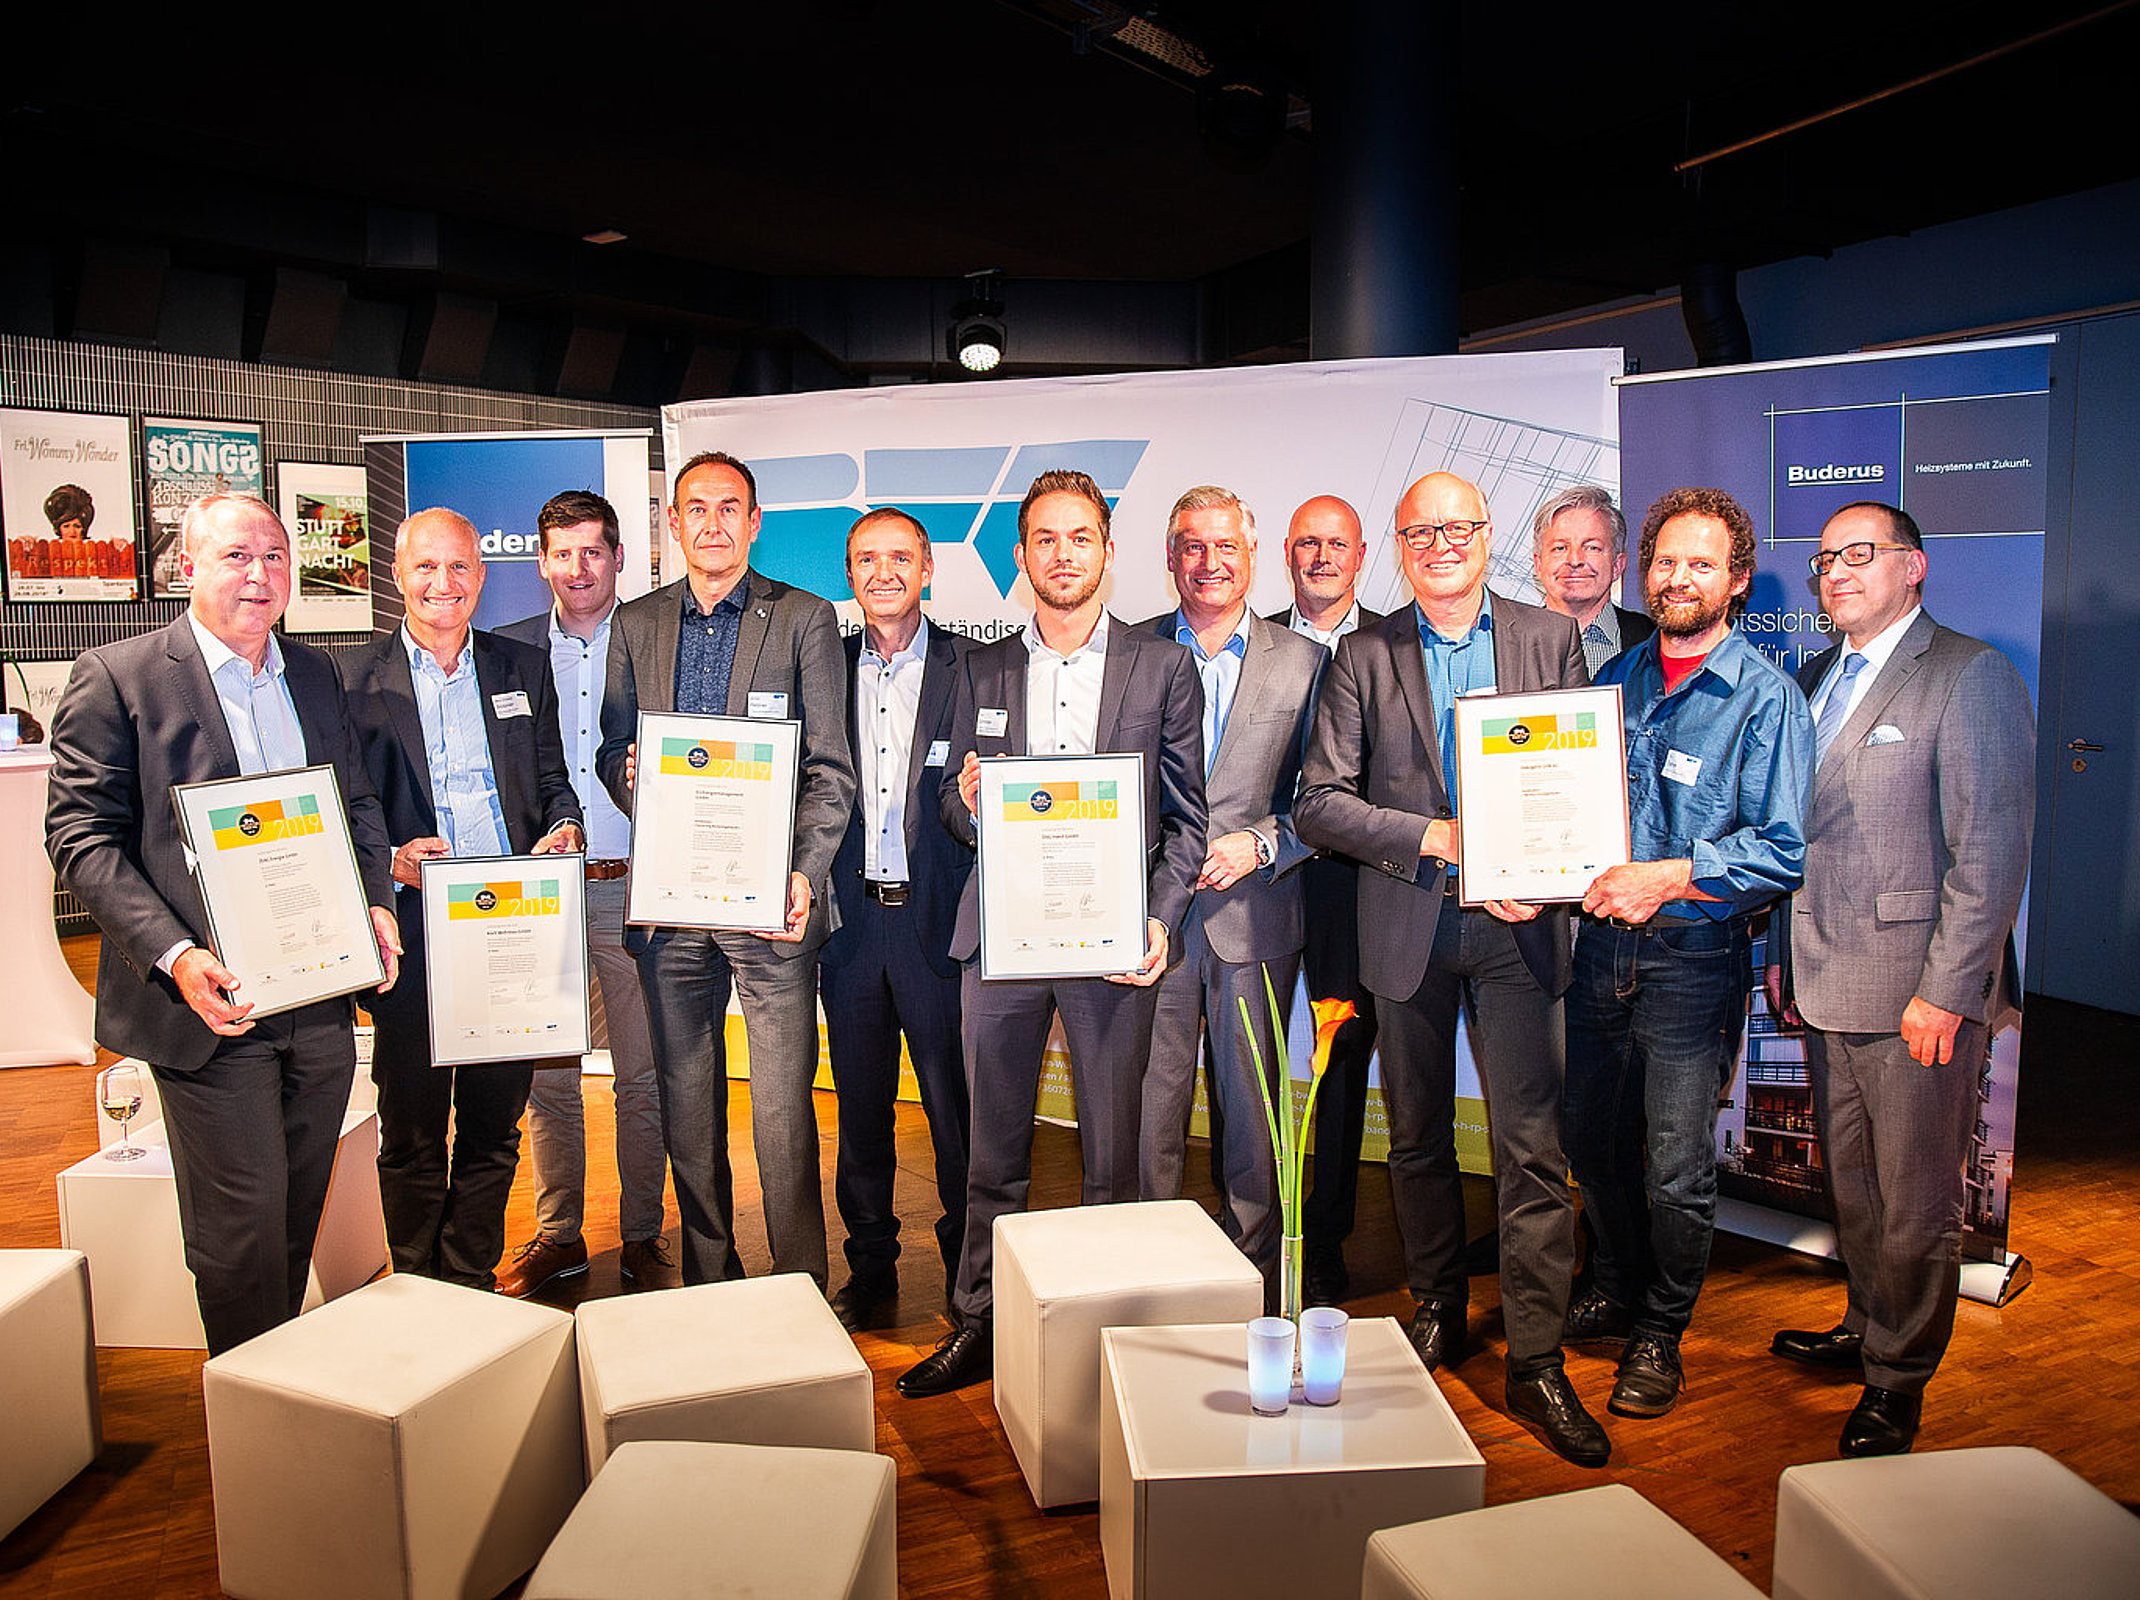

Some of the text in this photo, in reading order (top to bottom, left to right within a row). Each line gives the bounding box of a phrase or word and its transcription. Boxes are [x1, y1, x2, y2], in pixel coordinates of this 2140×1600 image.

[28, 437, 74, 463] Wommy
[75, 439, 119, 463] Wonder
[147, 436, 260, 475] SONGS
[1788, 463, 1885, 485] Buderus
[1915, 458, 2032, 475] Heizsysteme mit Zukunft.
[296, 519, 345, 535] STUTT
[300, 537, 342, 552] GART
[480, 529, 540, 554] der
[298, 553, 355, 569] NACHT
[1733, 607, 1836, 633] tssiche
[1543, 728, 1594, 752] 2019
[721, 759, 770, 782] 2019
[1065, 799, 1116, 821] 2019
[272, 813, 320, 841] 2019
[509, 896, 558, 918] 2019
